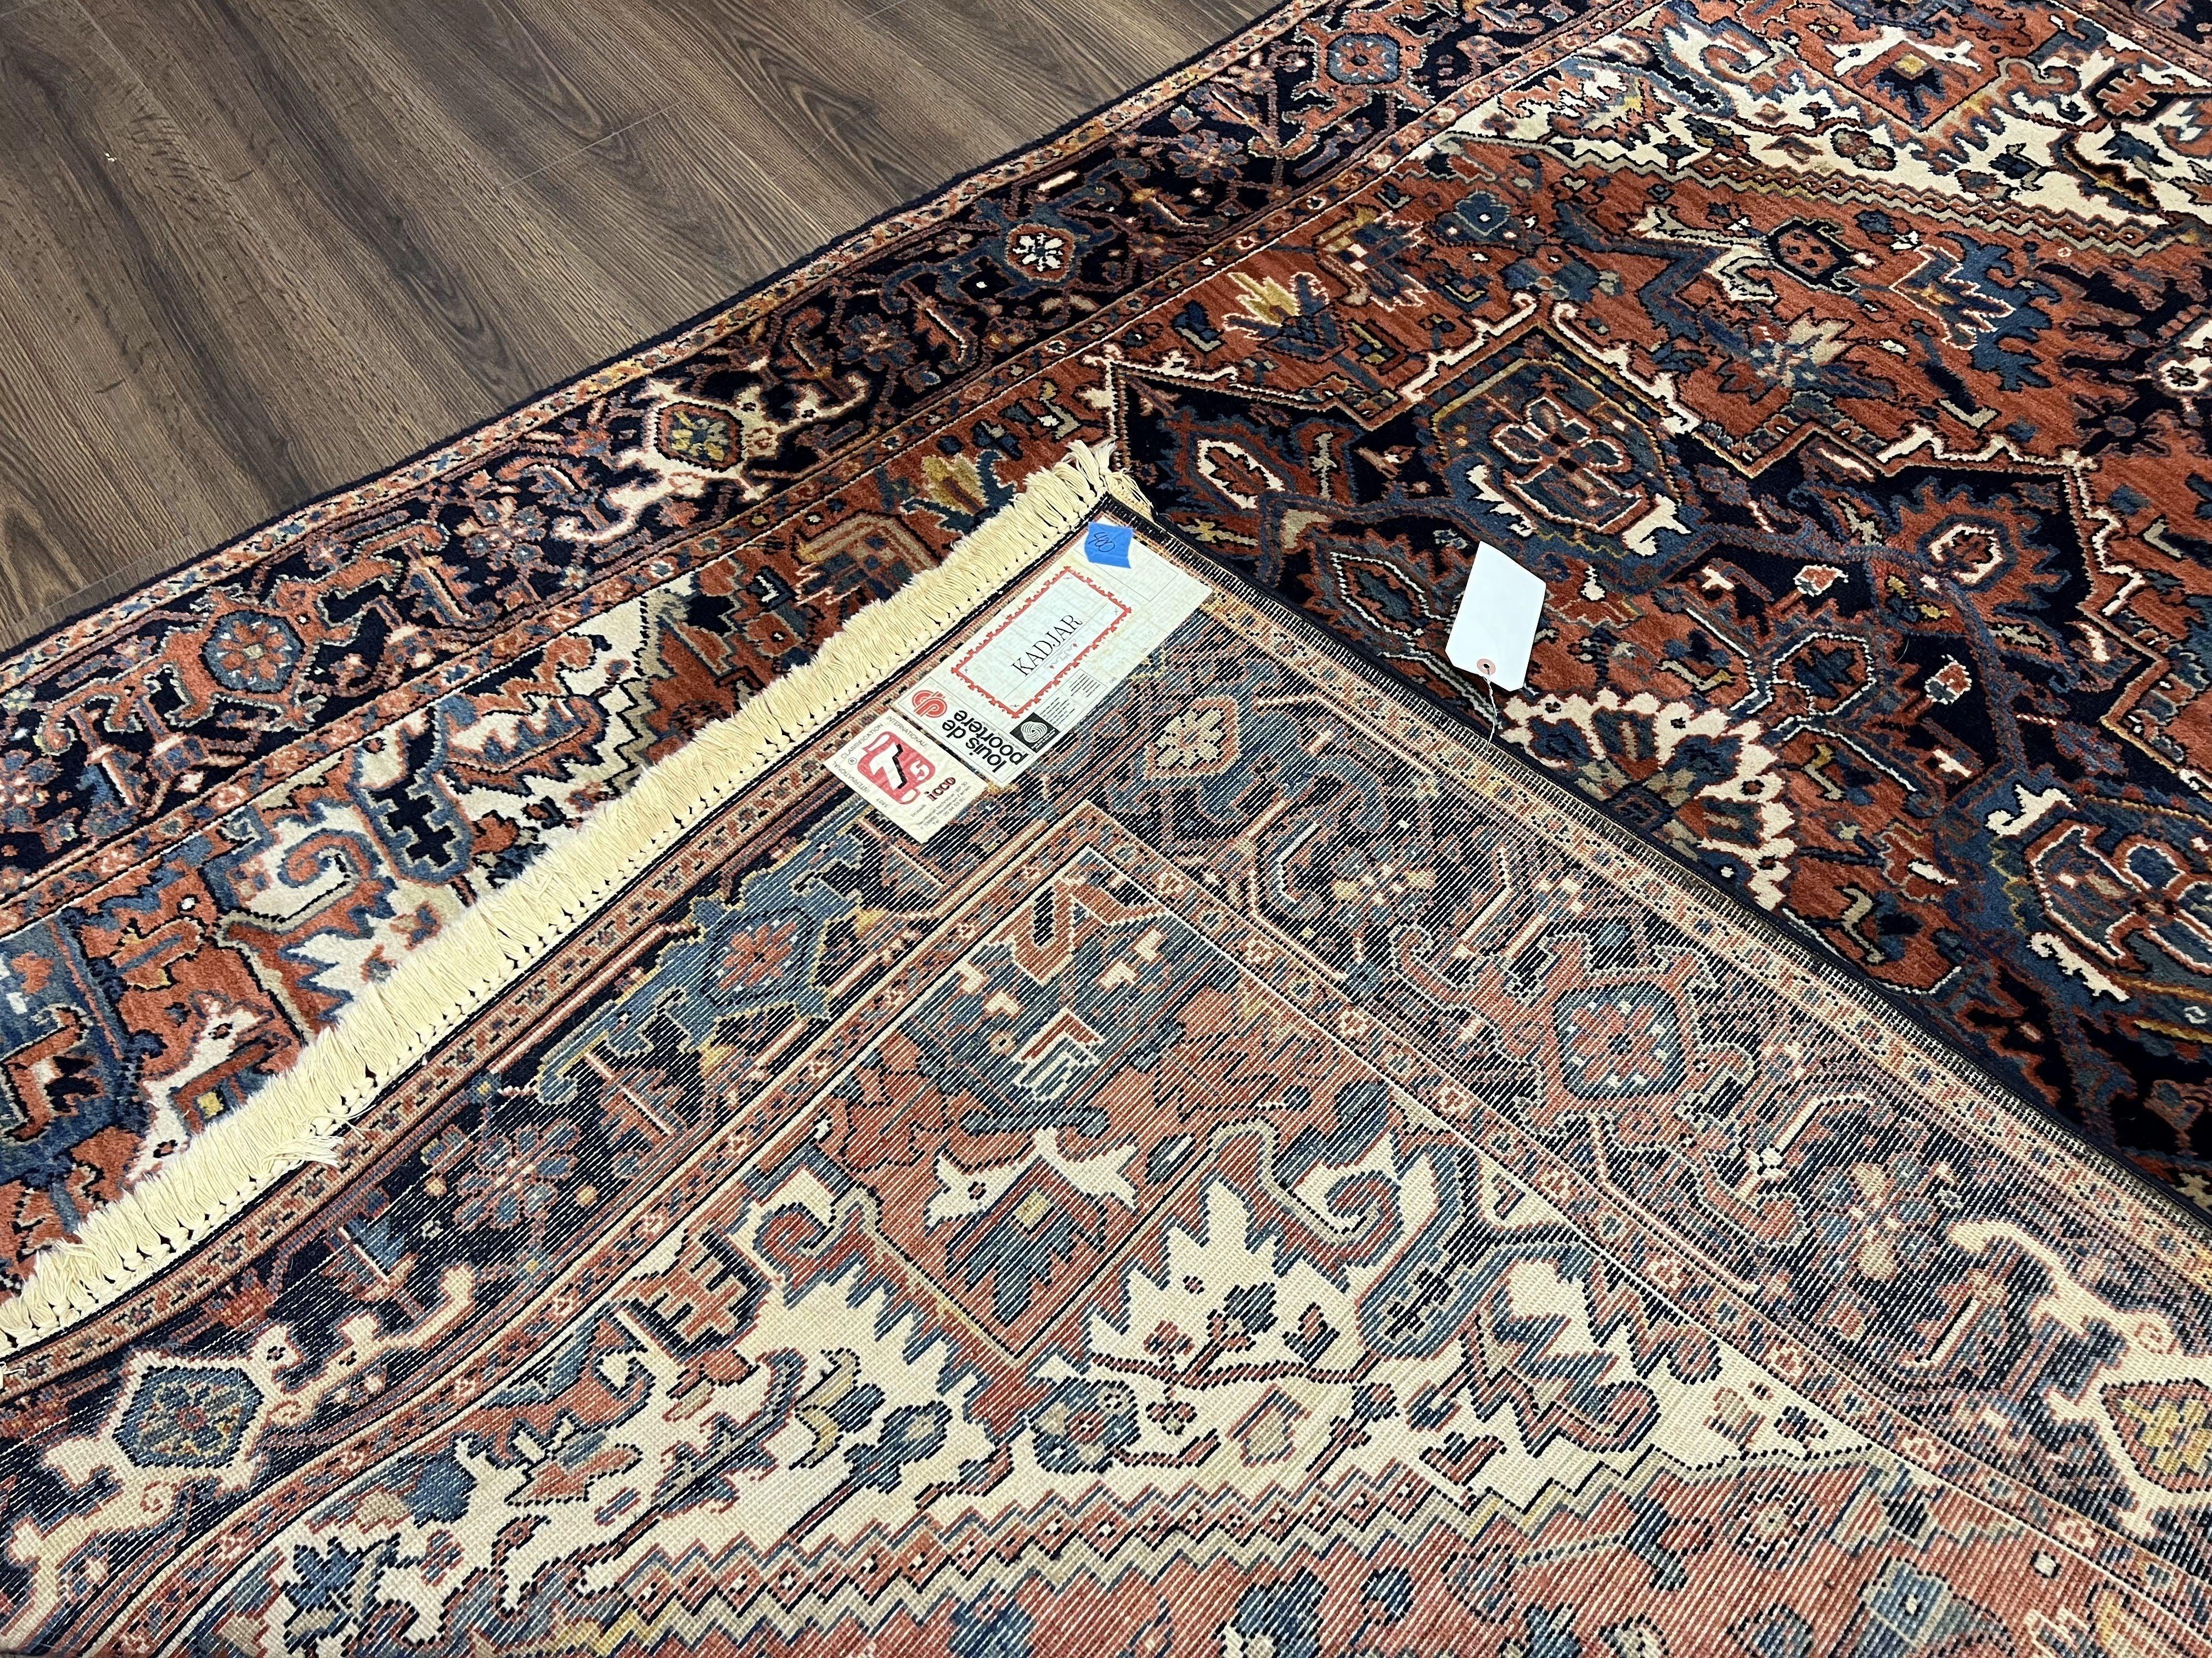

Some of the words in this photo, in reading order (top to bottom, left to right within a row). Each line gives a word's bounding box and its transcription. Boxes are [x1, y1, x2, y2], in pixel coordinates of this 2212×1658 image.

[1010, 615, 1083, 676] KADJAR
[841, 723, 884, 759] CLASSIFICATION
[886, 715, 930, 749] INTERNATIONALE
[942, 719, 966, 738] de
[954, 710, 1029, 765] poortere
[966, 737, 1006, 772] louis
[832, 761, 870, 793] INTERNATIONAL
[924, 777, 955, 801] icco
